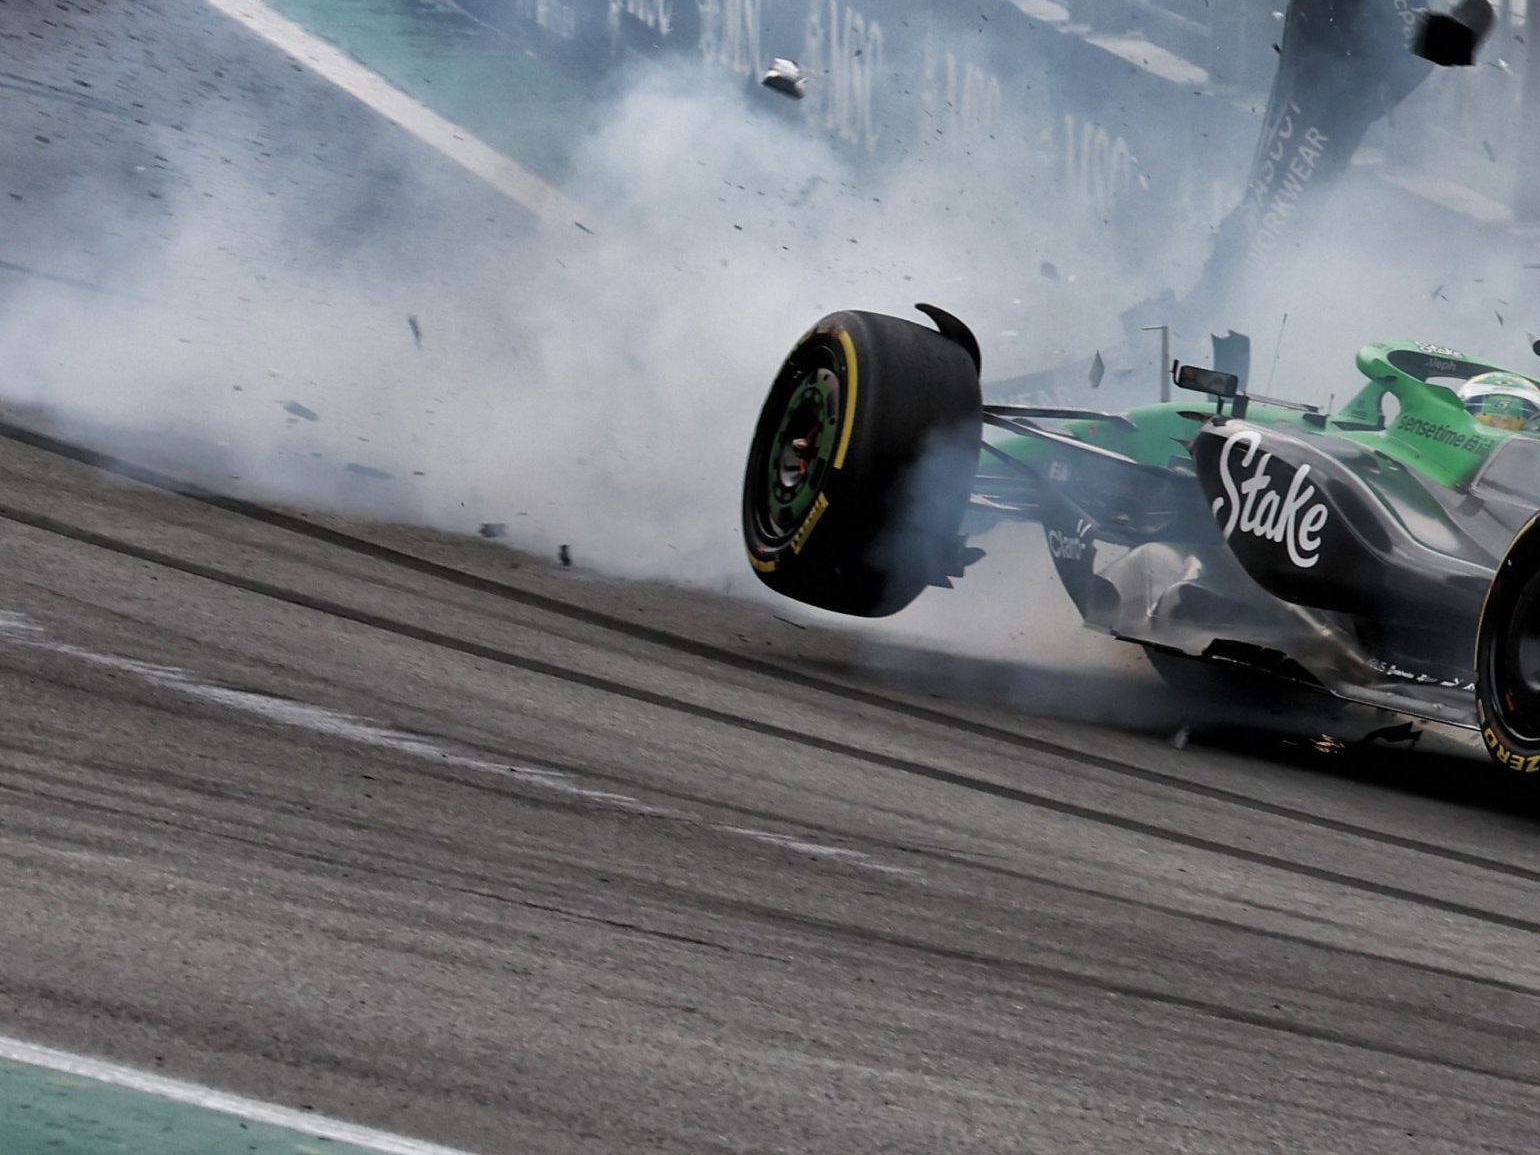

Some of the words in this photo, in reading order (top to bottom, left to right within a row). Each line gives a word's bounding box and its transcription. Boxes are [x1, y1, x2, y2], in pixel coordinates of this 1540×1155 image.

[1398, 415, 1465, 446] sensetime
[1212, 431, 1330, 568] Stake
[1483, 727, 1540, 773] ZERO
